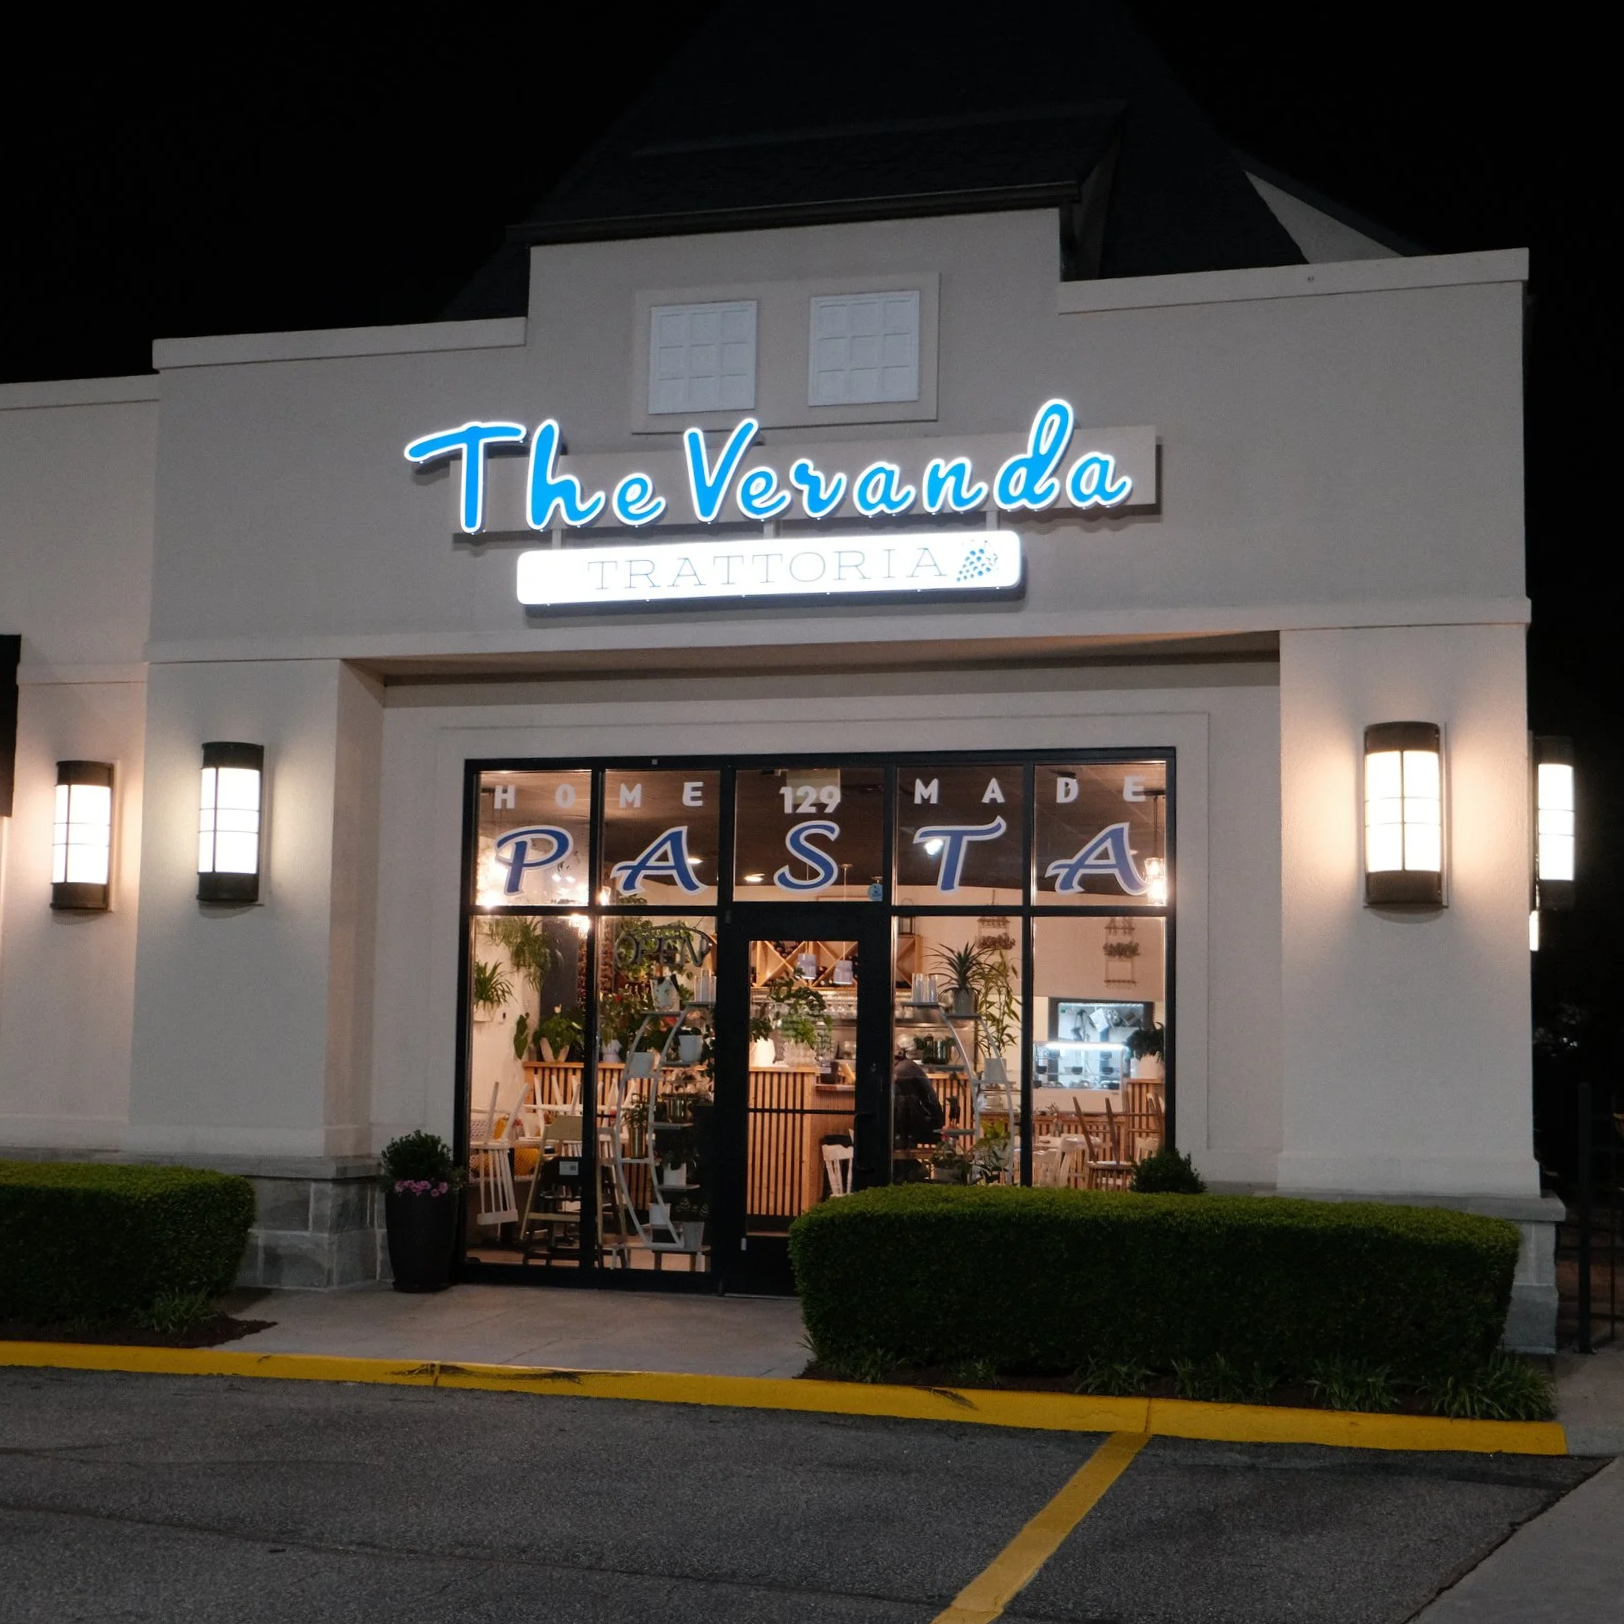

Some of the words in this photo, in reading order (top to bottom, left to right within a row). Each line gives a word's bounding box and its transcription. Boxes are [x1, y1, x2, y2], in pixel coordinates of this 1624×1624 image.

[403, 417, 666, 534] The
[682, 397, 1134, 523] Veranda
[587, 547, 948, 590] TRATTORIA
[493, 781, 704, 810] HOME
[913, 775, 1147, 804] MADE
[779, 784, 841, 815] 129
[494, 814, 1150, 897] PASTA
[614, 933, 712, 968] OPEN
